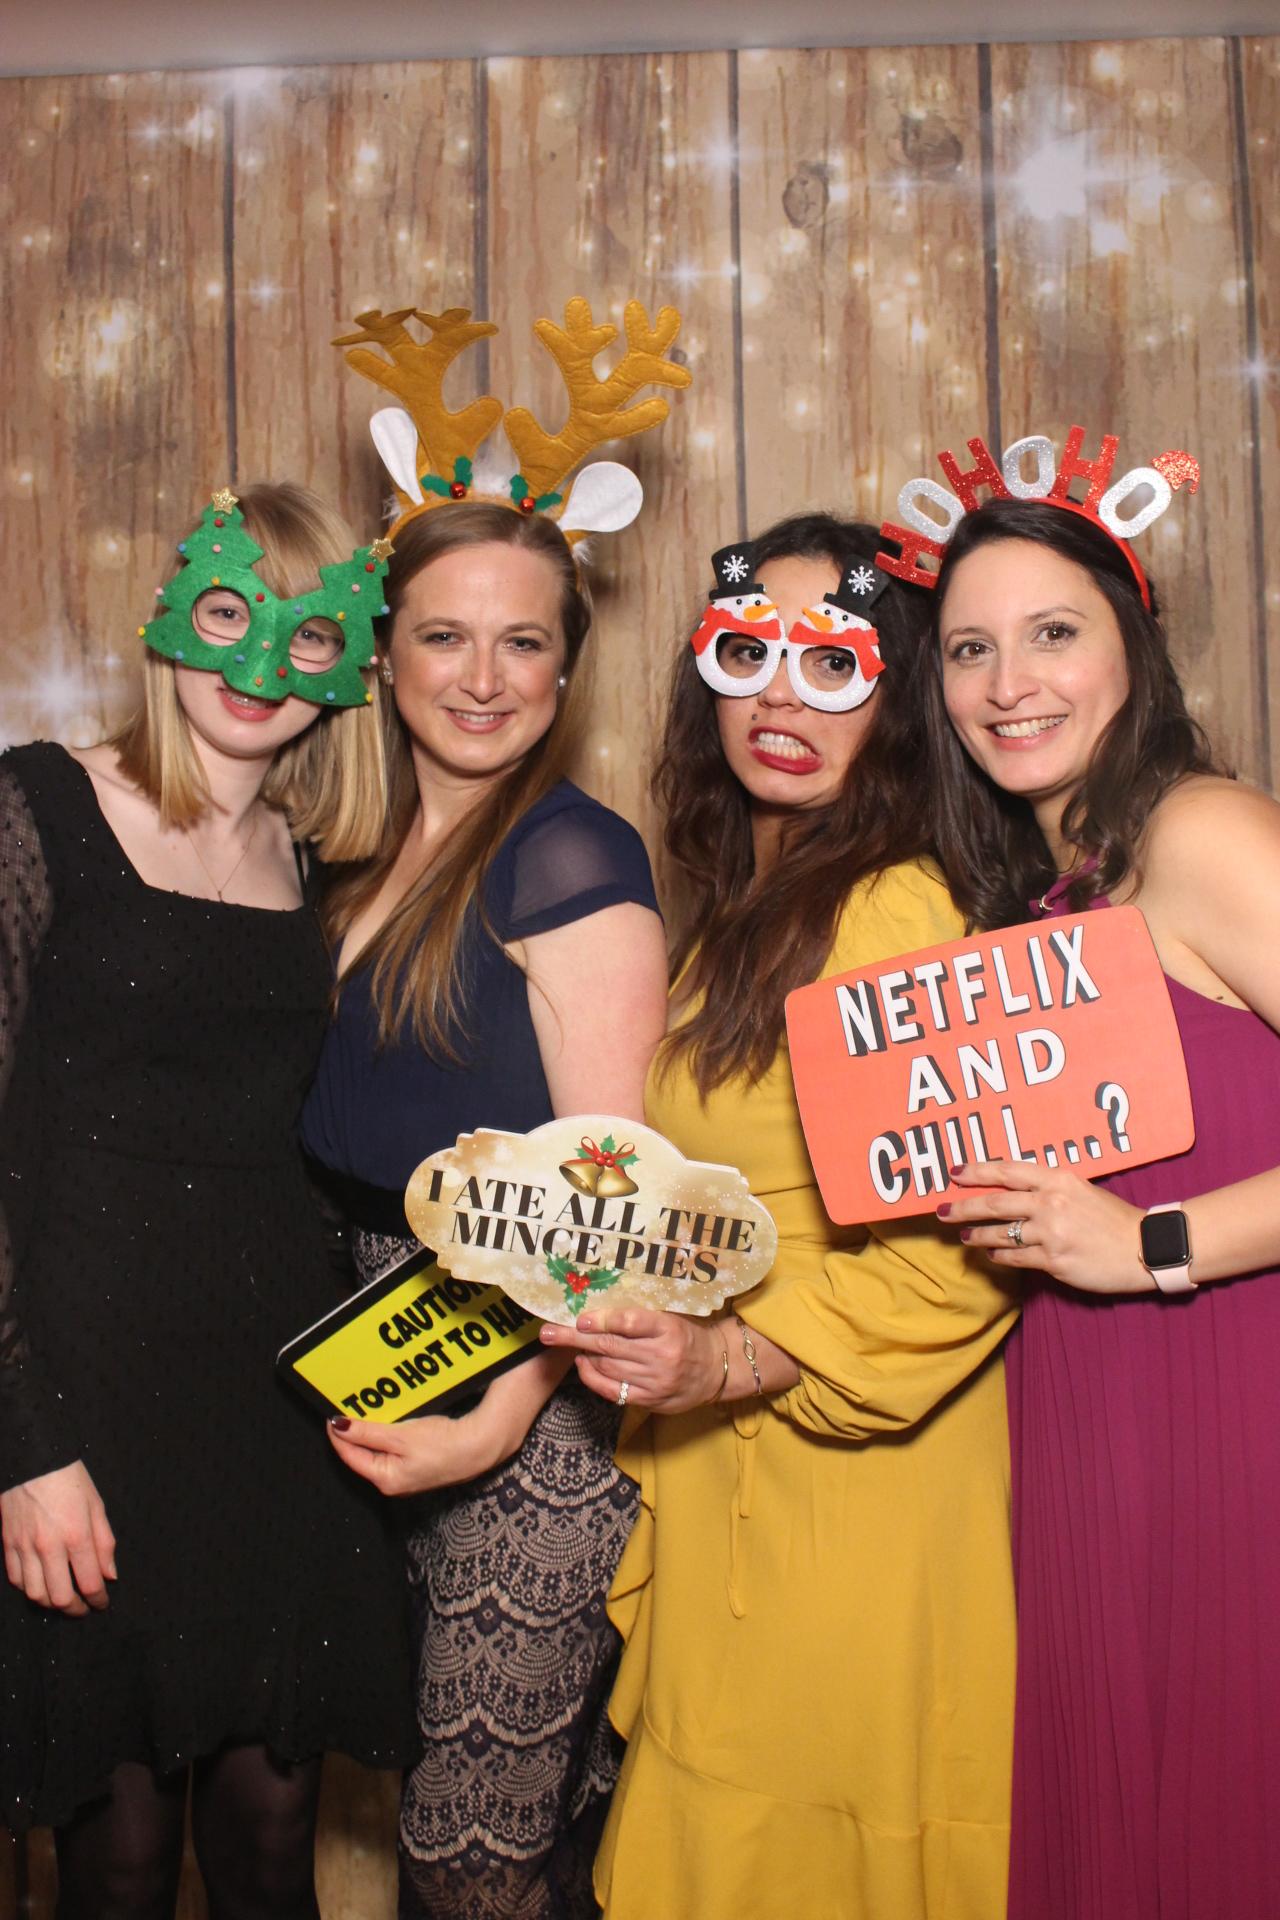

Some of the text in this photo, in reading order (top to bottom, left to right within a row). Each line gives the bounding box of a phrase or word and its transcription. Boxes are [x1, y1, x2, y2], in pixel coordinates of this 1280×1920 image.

[834, 923, 1101, 1057] NETFLIX
[906, 1027, 1067, 1114] AND
[426, 1168, 756, 1253] I ATE ALL THE
[448, 1210, 720, 1284] MINCE PIES
[341, 1376, 401, 1419] TOO
[393, 1339, 454, 1390] HOT
[444, 1321, 491, 1357] TO
